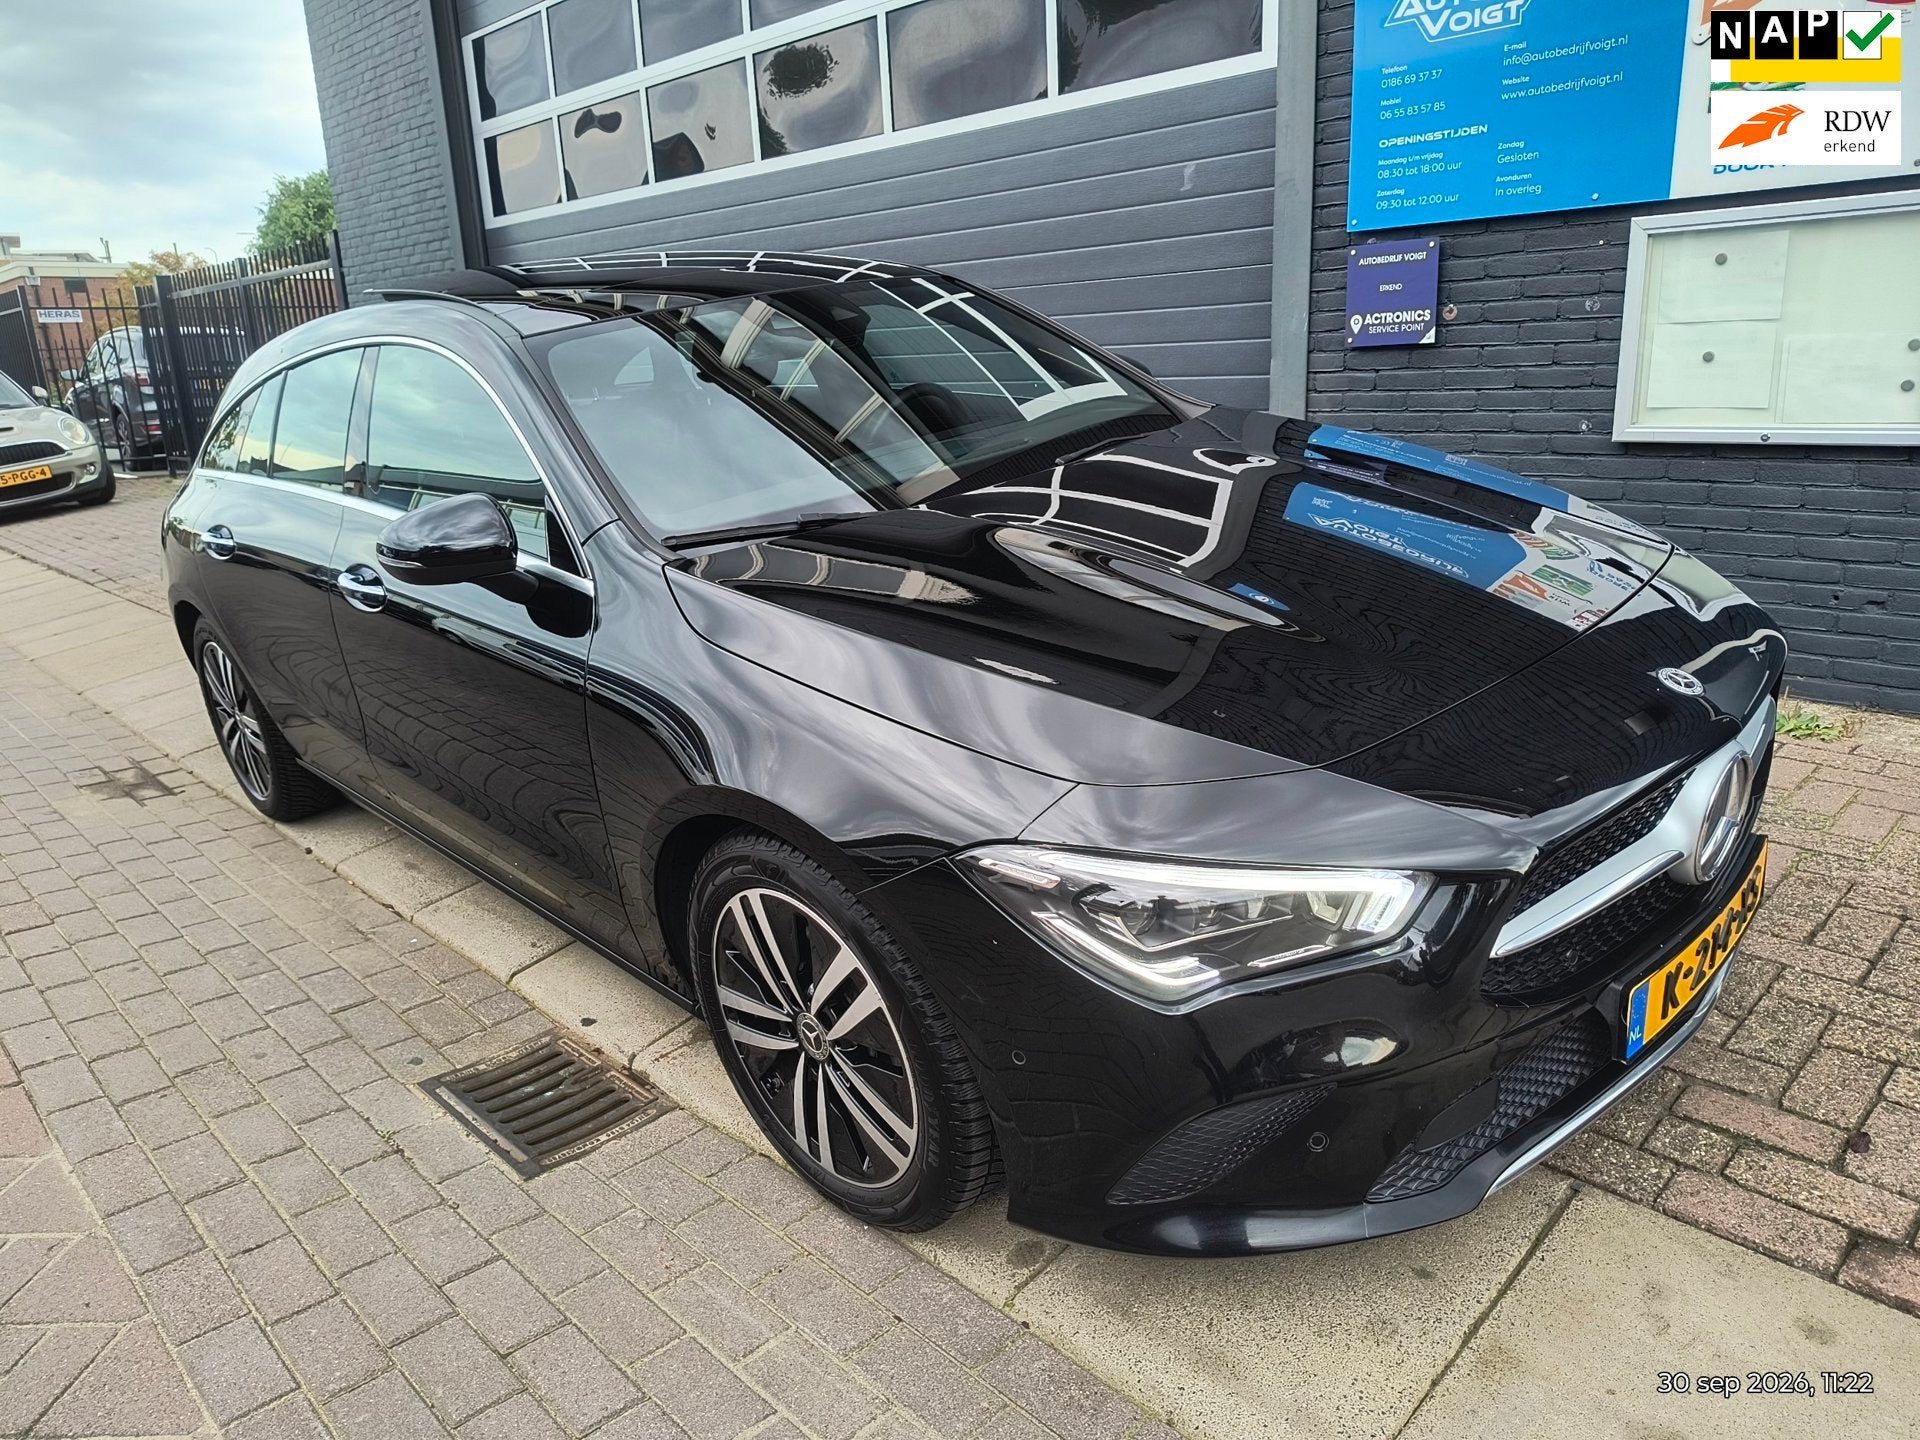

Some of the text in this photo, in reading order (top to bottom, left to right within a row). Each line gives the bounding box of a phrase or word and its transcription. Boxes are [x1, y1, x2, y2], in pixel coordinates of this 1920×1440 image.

[1420, 0, 1525, 36] VOIGT
[1503, 34, 1628, 66] info@autobedrijfvoigt.nl
[1504, 41, 1527, 52] E-mail
[1381, 65, 1407, 75] Telefoon
[1381, 69, 1442, 88] 0186 69 37 37
[1501, 71, 1623, 100] www.autobedrijfvoigt.nl
[1502, 76, 1530, 85] Website
[1380, 97, 1401, 106] Mobiel
[1380, 101, 1446, 120] 06 55 83 57 85
[1378, 124, 1488, 148] OPENINGSTIJDEN
[1497, 141, 1525, 149] Zondag
[1378, 152, 1444, 166] Maandag t/m vrijdag
[1497, 151, 1539, 163] Gesloten
[1377, 161, 1462, 179] 08:30 tot 18:00 uur
[1496, 173, 1532, 182] Avonduren
[1376, 188, 1405, 197] Zaterdag
[1495, 184, 1541, 196] In overleg
[1376, 194, 1459, 210] 09:30 tot 12:00 uur
[1358, 252, 1427, 266] AUTOBEDRIJF VOIGT
[1380, 283, 1402, 292] ERKEND
[1364, 310, 1431, 325] ACTRONICS
[1369, 323, 1424, 334] SERVICE POINT
[1629, 1030, 1642, 1046] NL
